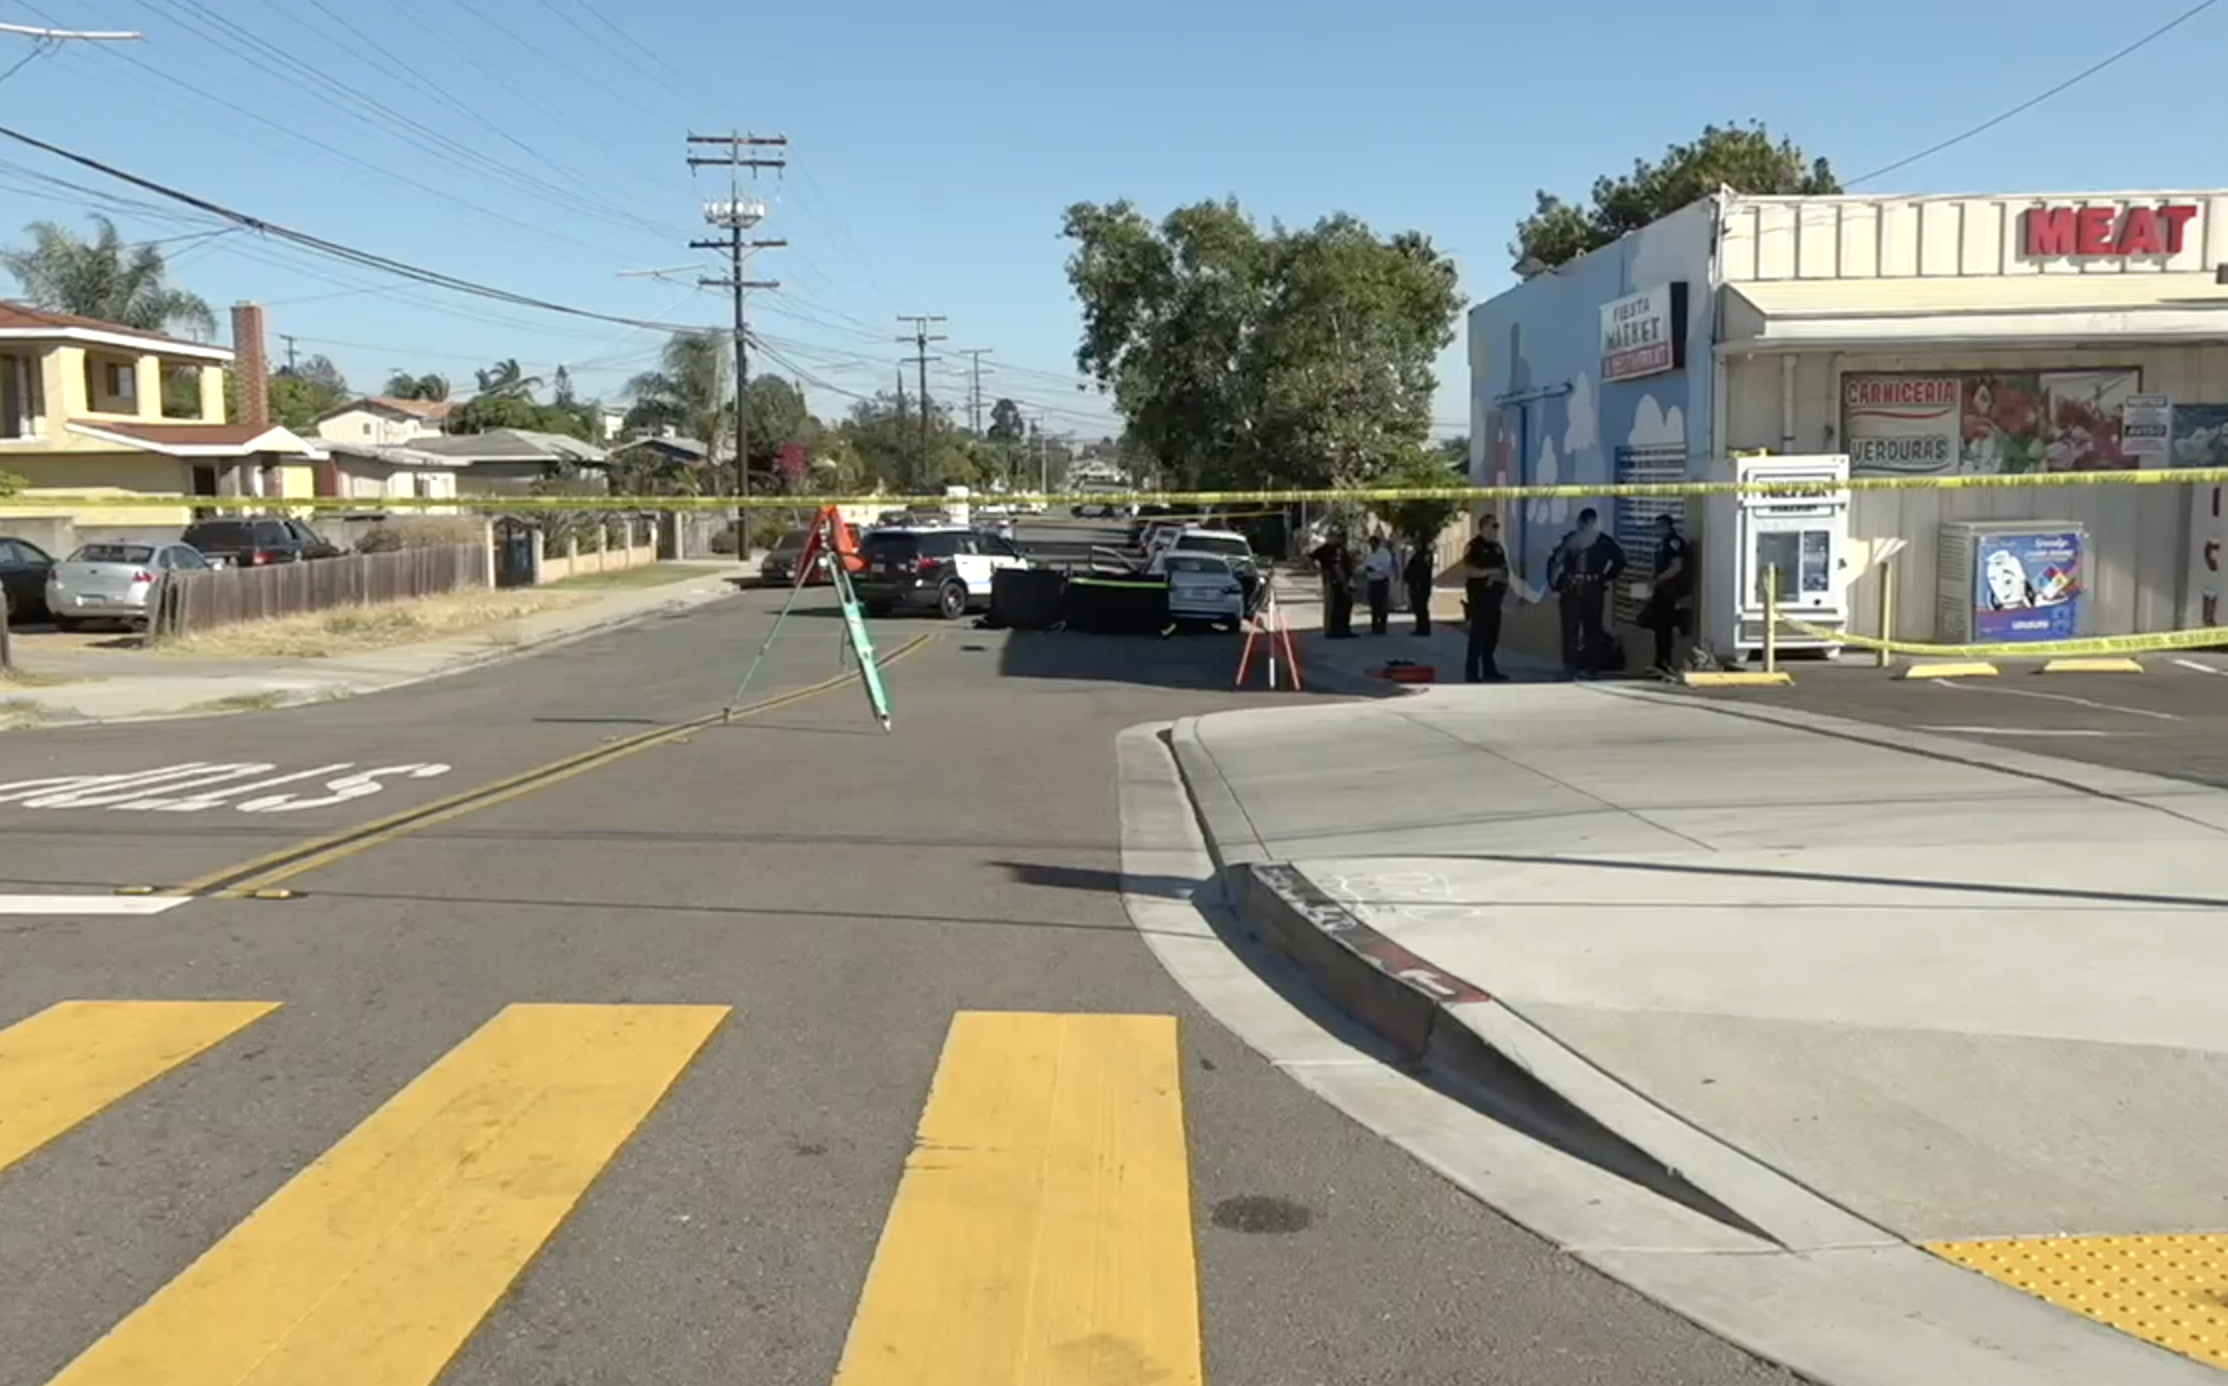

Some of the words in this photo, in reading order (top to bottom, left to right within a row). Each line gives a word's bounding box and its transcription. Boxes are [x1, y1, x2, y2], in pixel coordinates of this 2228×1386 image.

[2025, 205, 2198, 256] MEAT
[1613, 298, 1650, 323] FIESTA
[1849, 380, 1956, 405] CARNICERIA
[1851, 437, 1948, 462] VERDURAS
